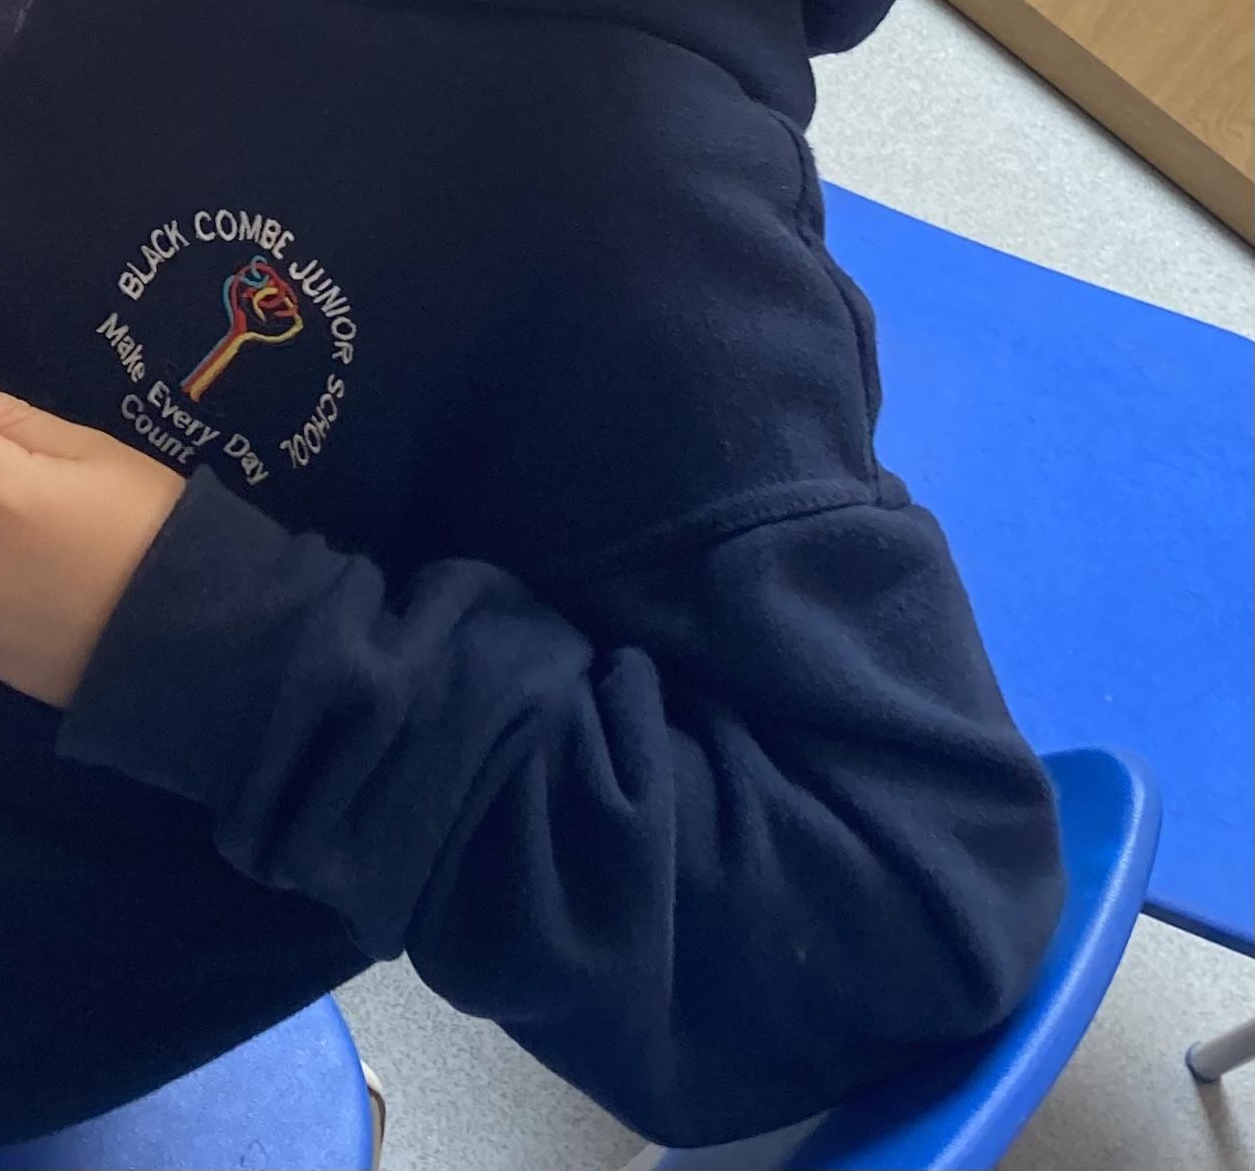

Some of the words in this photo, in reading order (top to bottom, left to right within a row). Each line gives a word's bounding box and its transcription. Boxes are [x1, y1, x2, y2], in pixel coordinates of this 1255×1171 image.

[118, 220, 190, 301] BLACK
[194, 209, 295, 259] COMBE
[288, 259, 357, 364] JUNIOR
[96, 312, 146, 382] Make
[147, 380, 220, 447] Every
[223, 434, 269, 486] Day
[121, 394, 195, 465] Count
[280, 374, 345, 468] SCHOOL
